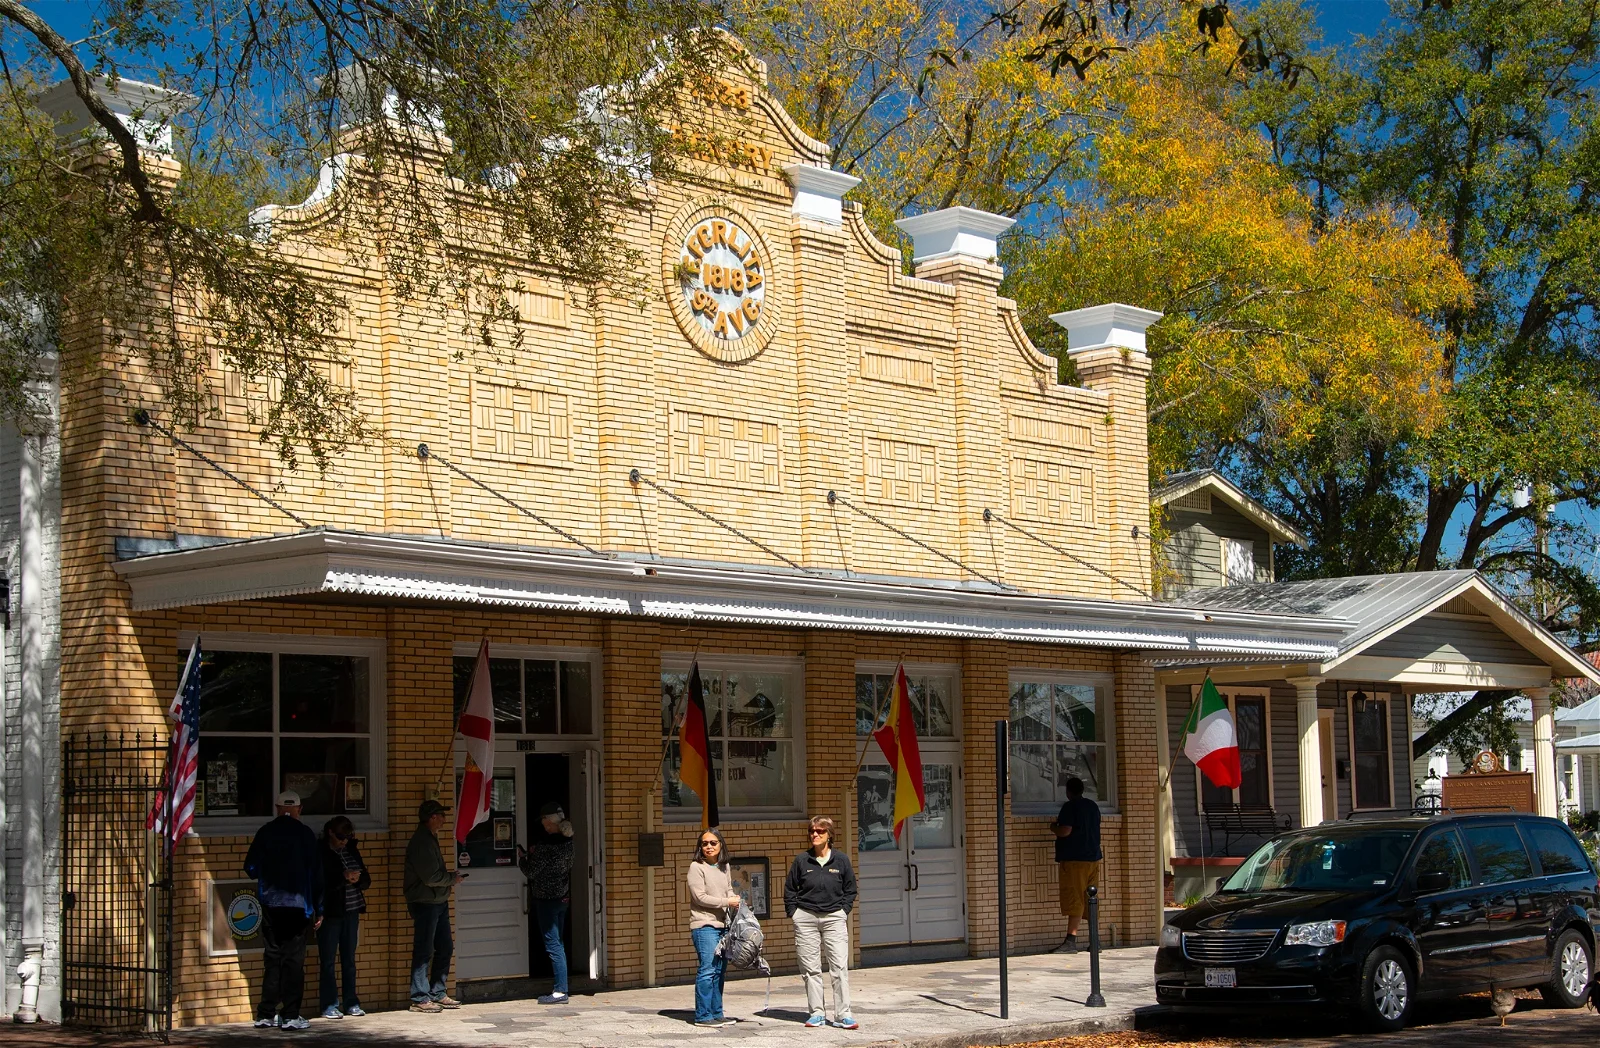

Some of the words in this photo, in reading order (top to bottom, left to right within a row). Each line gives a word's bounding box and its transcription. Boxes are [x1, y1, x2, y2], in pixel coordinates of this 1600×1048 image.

[687, 221, 763, 288] FERLITA
[703, 263, 744, 292] 1818
[1431, 662, 1447, 673] 1820
[713, 767, 746, 782] UEUM
[234, 889, 256, 897] FLORIDA
